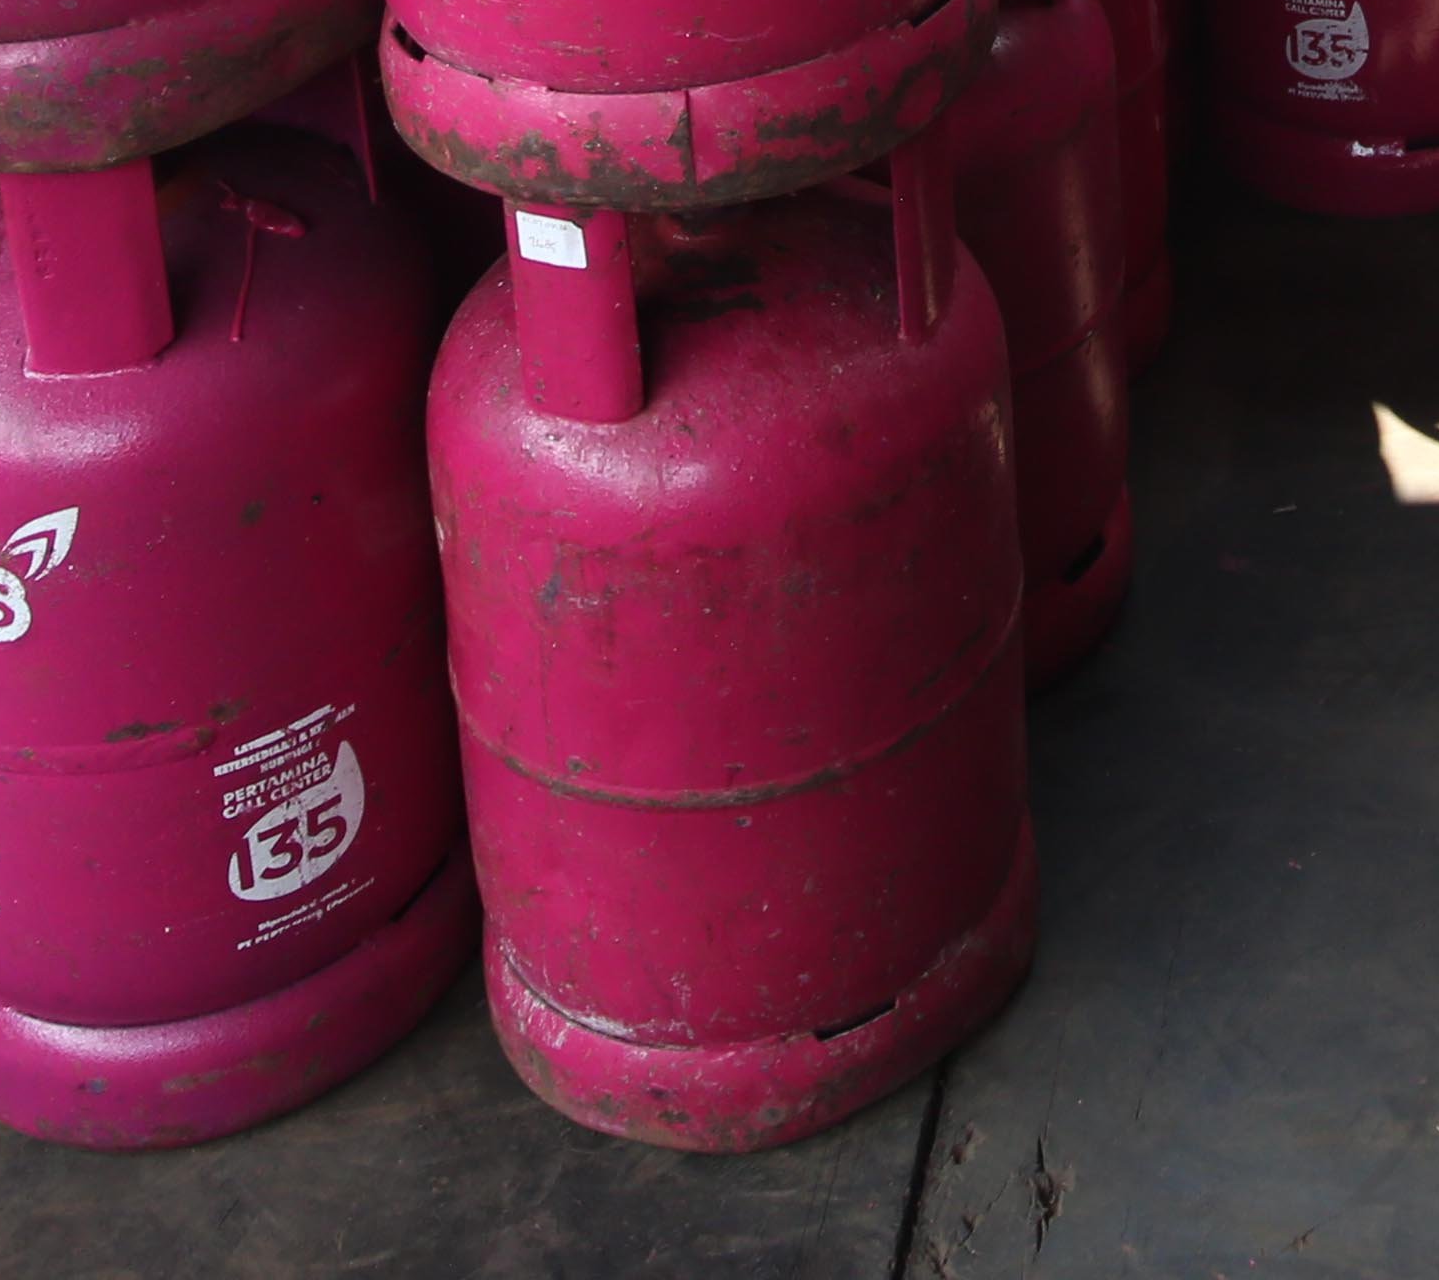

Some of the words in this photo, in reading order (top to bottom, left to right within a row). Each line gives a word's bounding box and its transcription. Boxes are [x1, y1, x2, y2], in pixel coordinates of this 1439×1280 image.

[1284, 2, 1308, 15] CALL
[1290, 29, 1357, 68] 135
[221, 794, 267, 820] CALL
[269, 762, 334, 803] CENTER
[222, 750, 331, 807] PERTAMINA
[235, 792, 350, 893] 135
